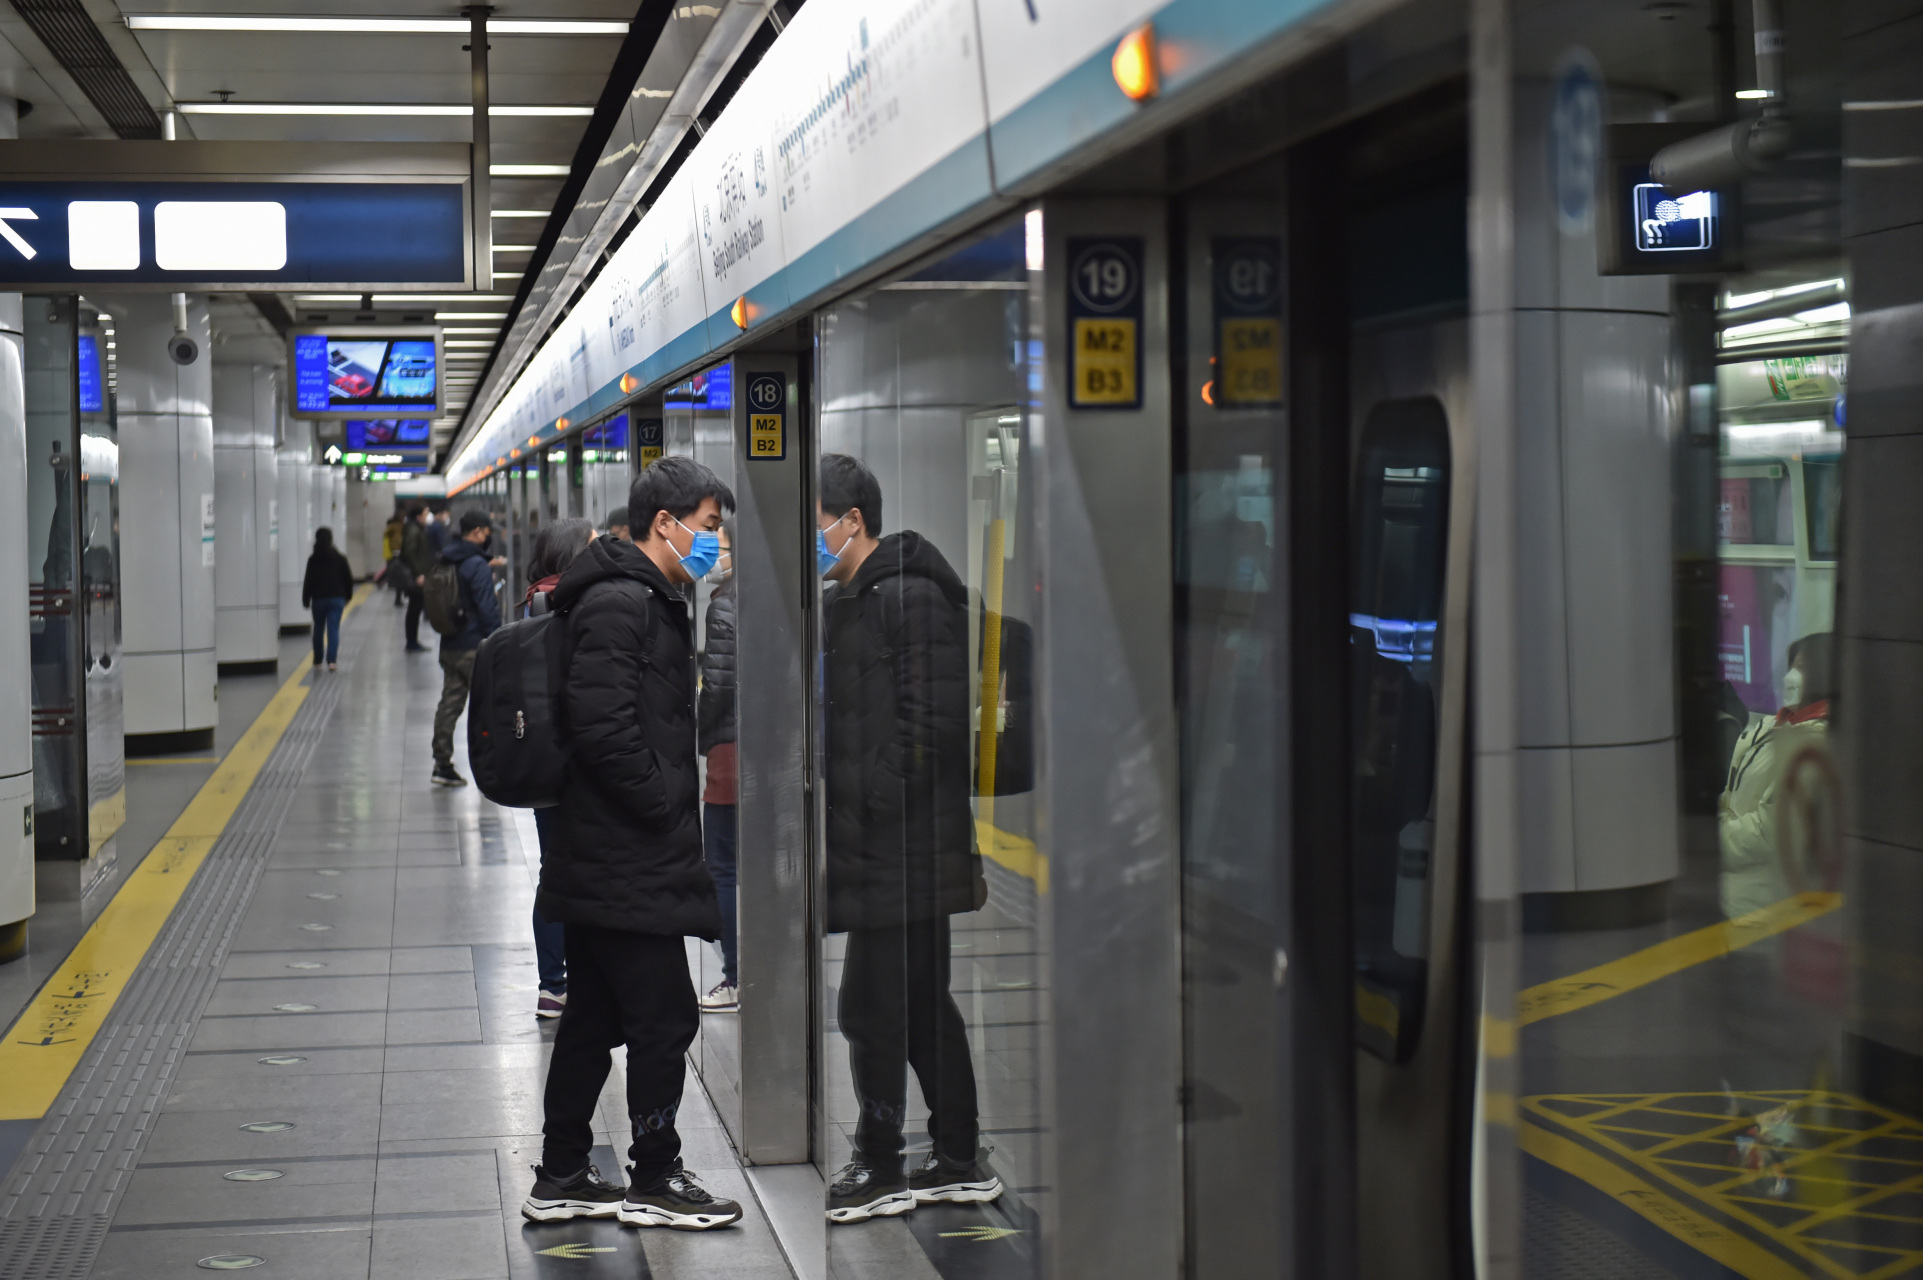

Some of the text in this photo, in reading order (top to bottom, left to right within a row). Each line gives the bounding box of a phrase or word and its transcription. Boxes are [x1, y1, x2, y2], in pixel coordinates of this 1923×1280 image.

[713, 215, 764, 281] Beijing South Railway Station
[1082, 258, 1127, 298] 19
[1085, 327, 1125, 351] M2
[1086, 368, 1123, 395] B3
[754, 383, 777, 403] 18
[642, 426, 658, 439] 17
[756, 418, 777, 431] M2
[643, 449, 658, 458] M2
[756, 439, 776, 452] B2
